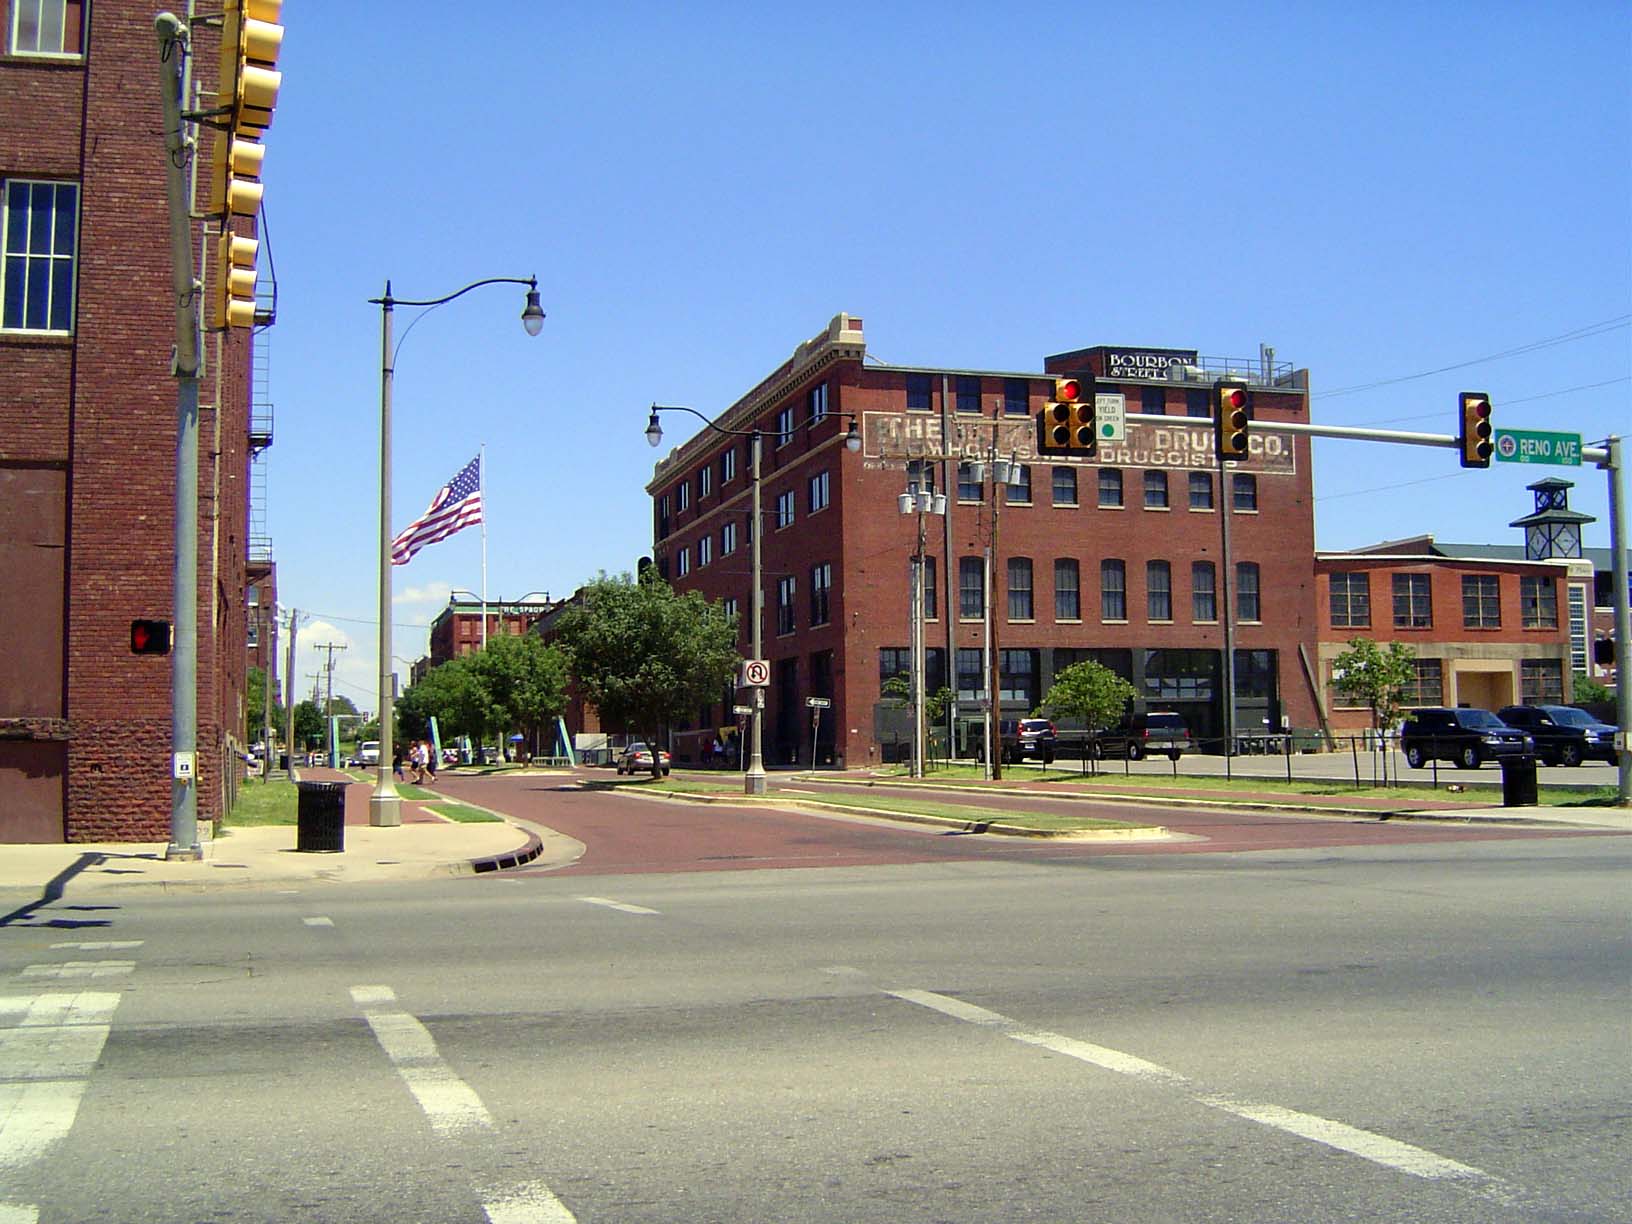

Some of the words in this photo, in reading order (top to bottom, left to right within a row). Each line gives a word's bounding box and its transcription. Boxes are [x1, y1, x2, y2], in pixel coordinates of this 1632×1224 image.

[1110, 354, 1192, 368] BOURBON
[1098, 406, 1116, 414] YIELD
[1155, 428, 1216, 451] DRU
[1247, 434, 1289, 456] CO.
[1520, 438, 1551, 456] RENO
